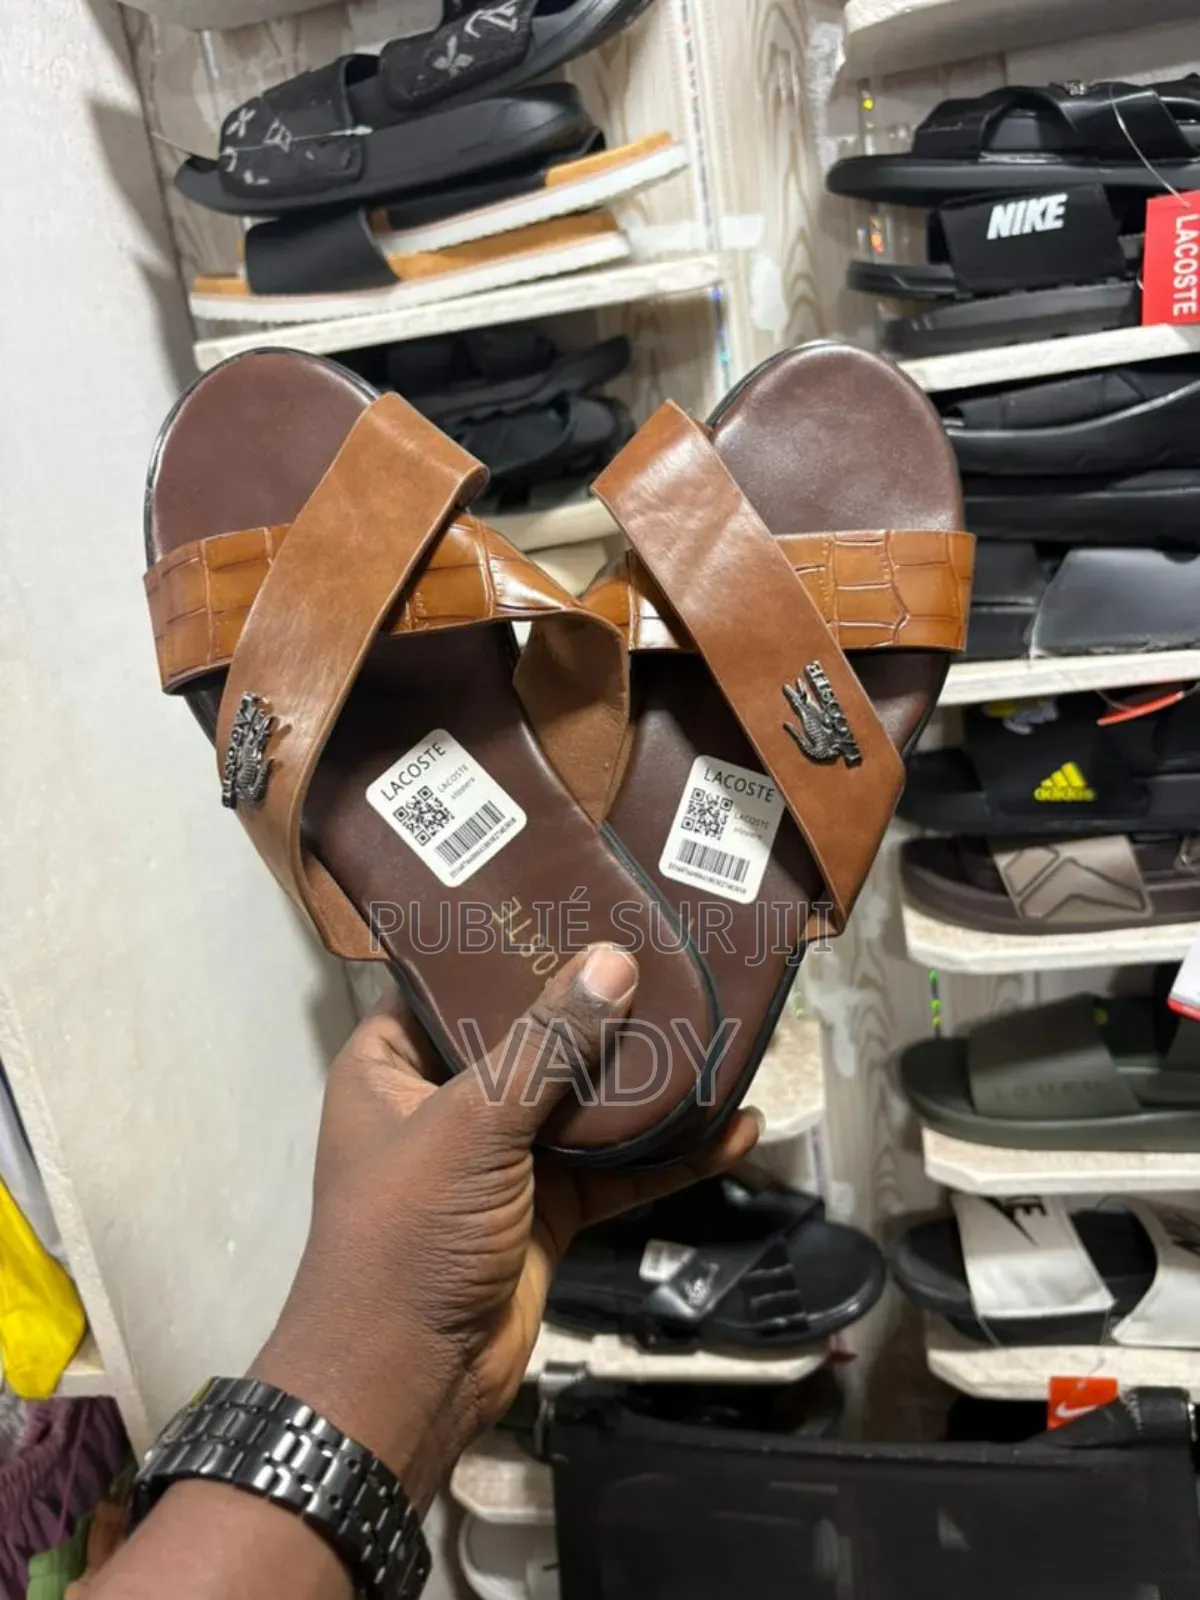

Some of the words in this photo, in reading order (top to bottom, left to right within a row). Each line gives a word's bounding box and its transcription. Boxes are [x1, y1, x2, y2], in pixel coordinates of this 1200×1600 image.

[986, 193, 1069, 241] NIKE
[1172, 213, 1200, 317] LACOSTE
[380, 741, 447, 802] LACOSTE
[437, 763, 470, 794] LACOSTE
[703, 767, 776, 803] LACOSTE
[492, 895, 560, 976] OSTE
